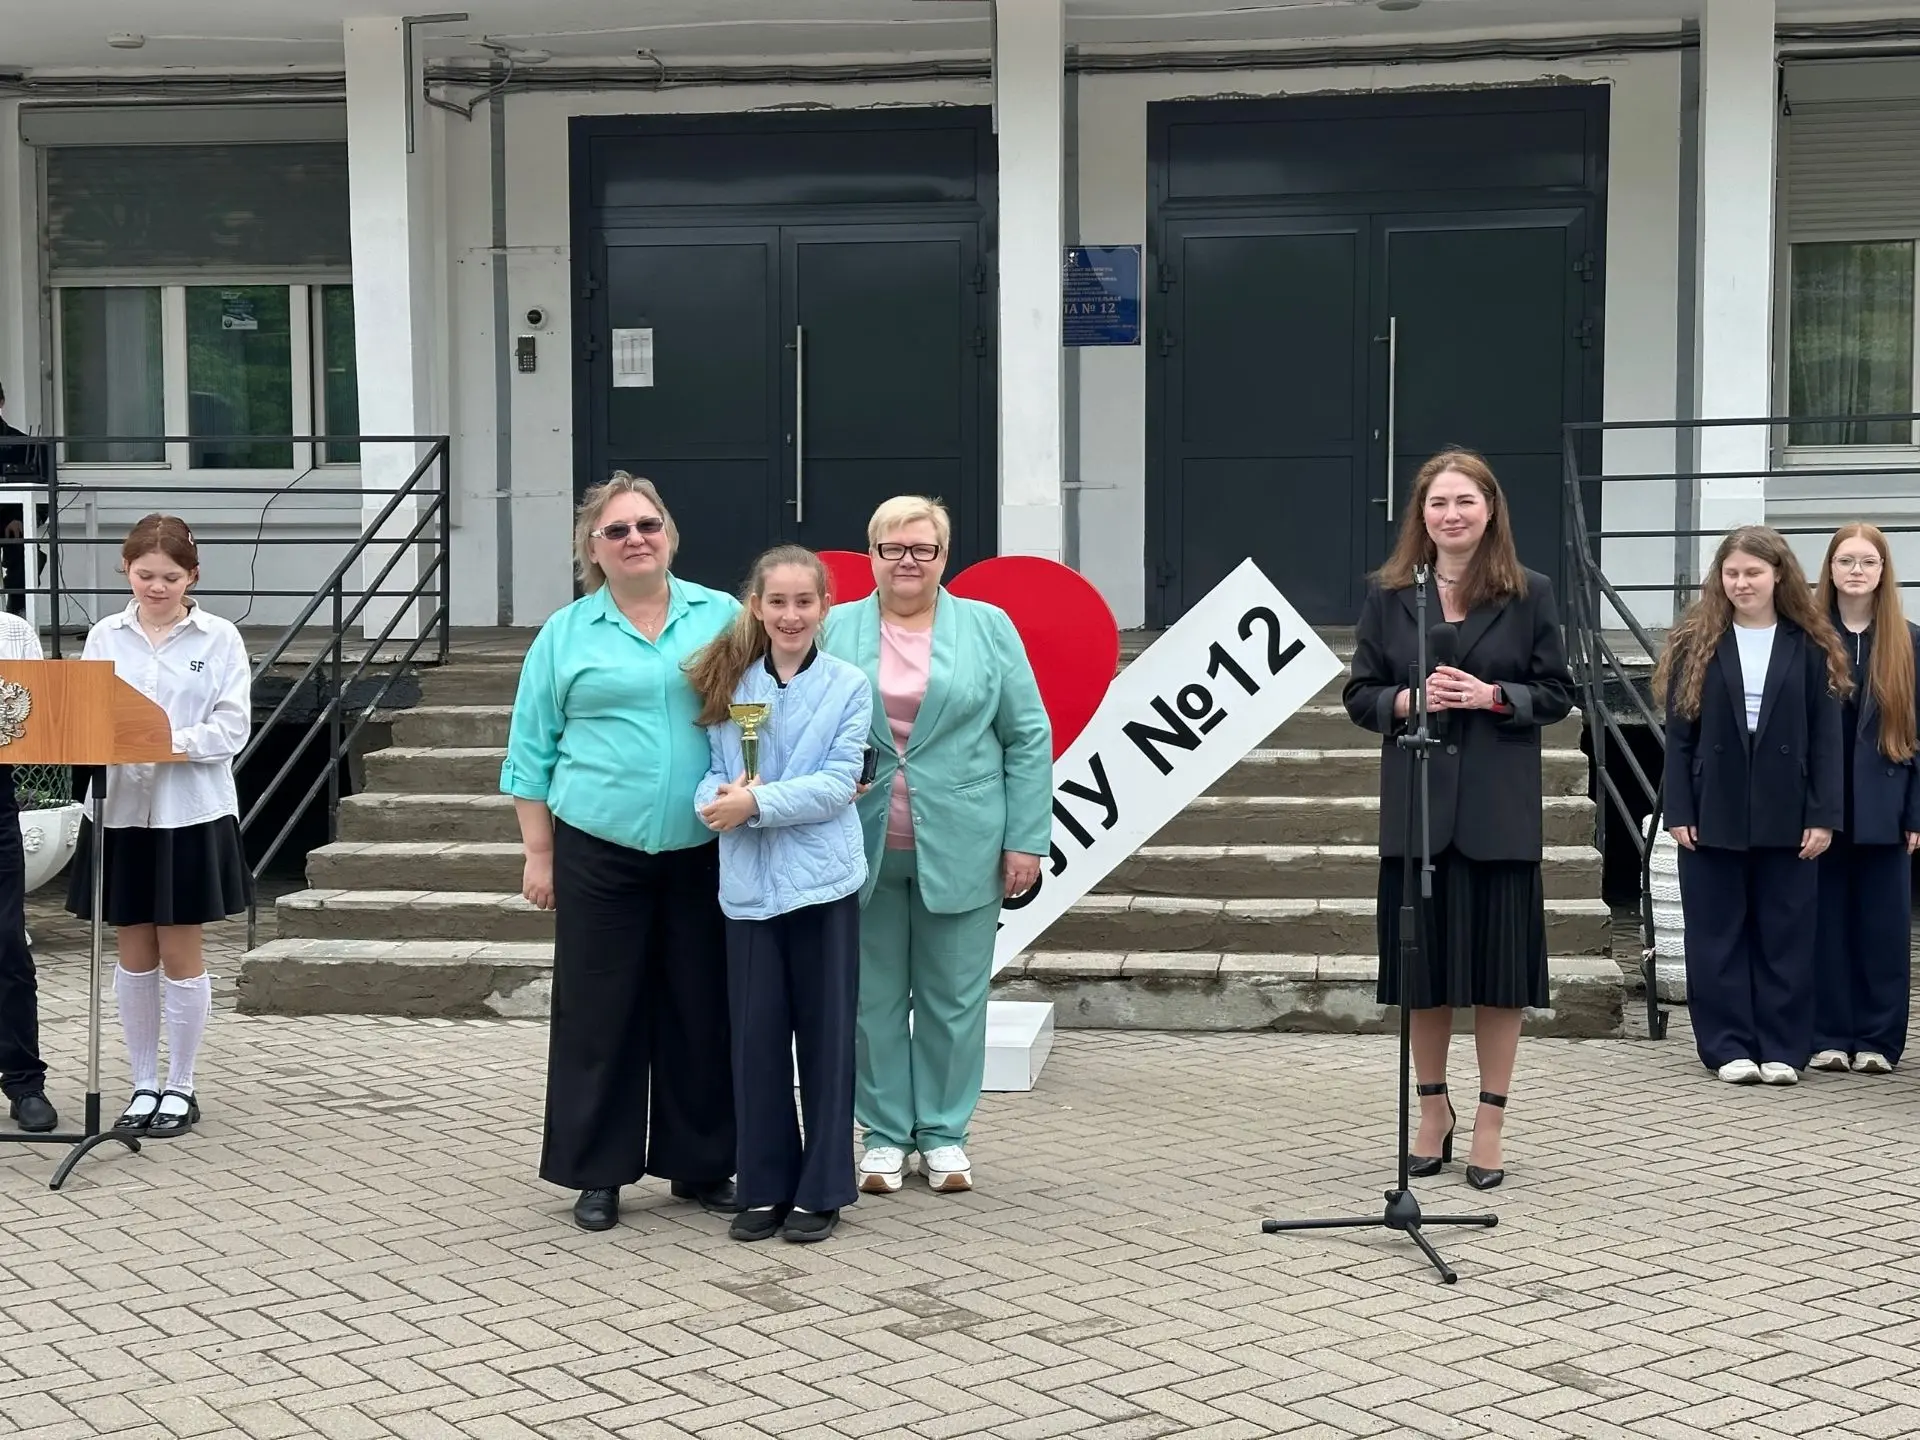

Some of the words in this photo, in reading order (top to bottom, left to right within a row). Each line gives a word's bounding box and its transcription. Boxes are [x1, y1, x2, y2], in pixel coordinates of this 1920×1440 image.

[1082, 303, 1096, 314] №
[1100, 302, 1116, 313] 12
[190, 660, 205, 672] SF
[1122, 606, 1306, 776] №12
